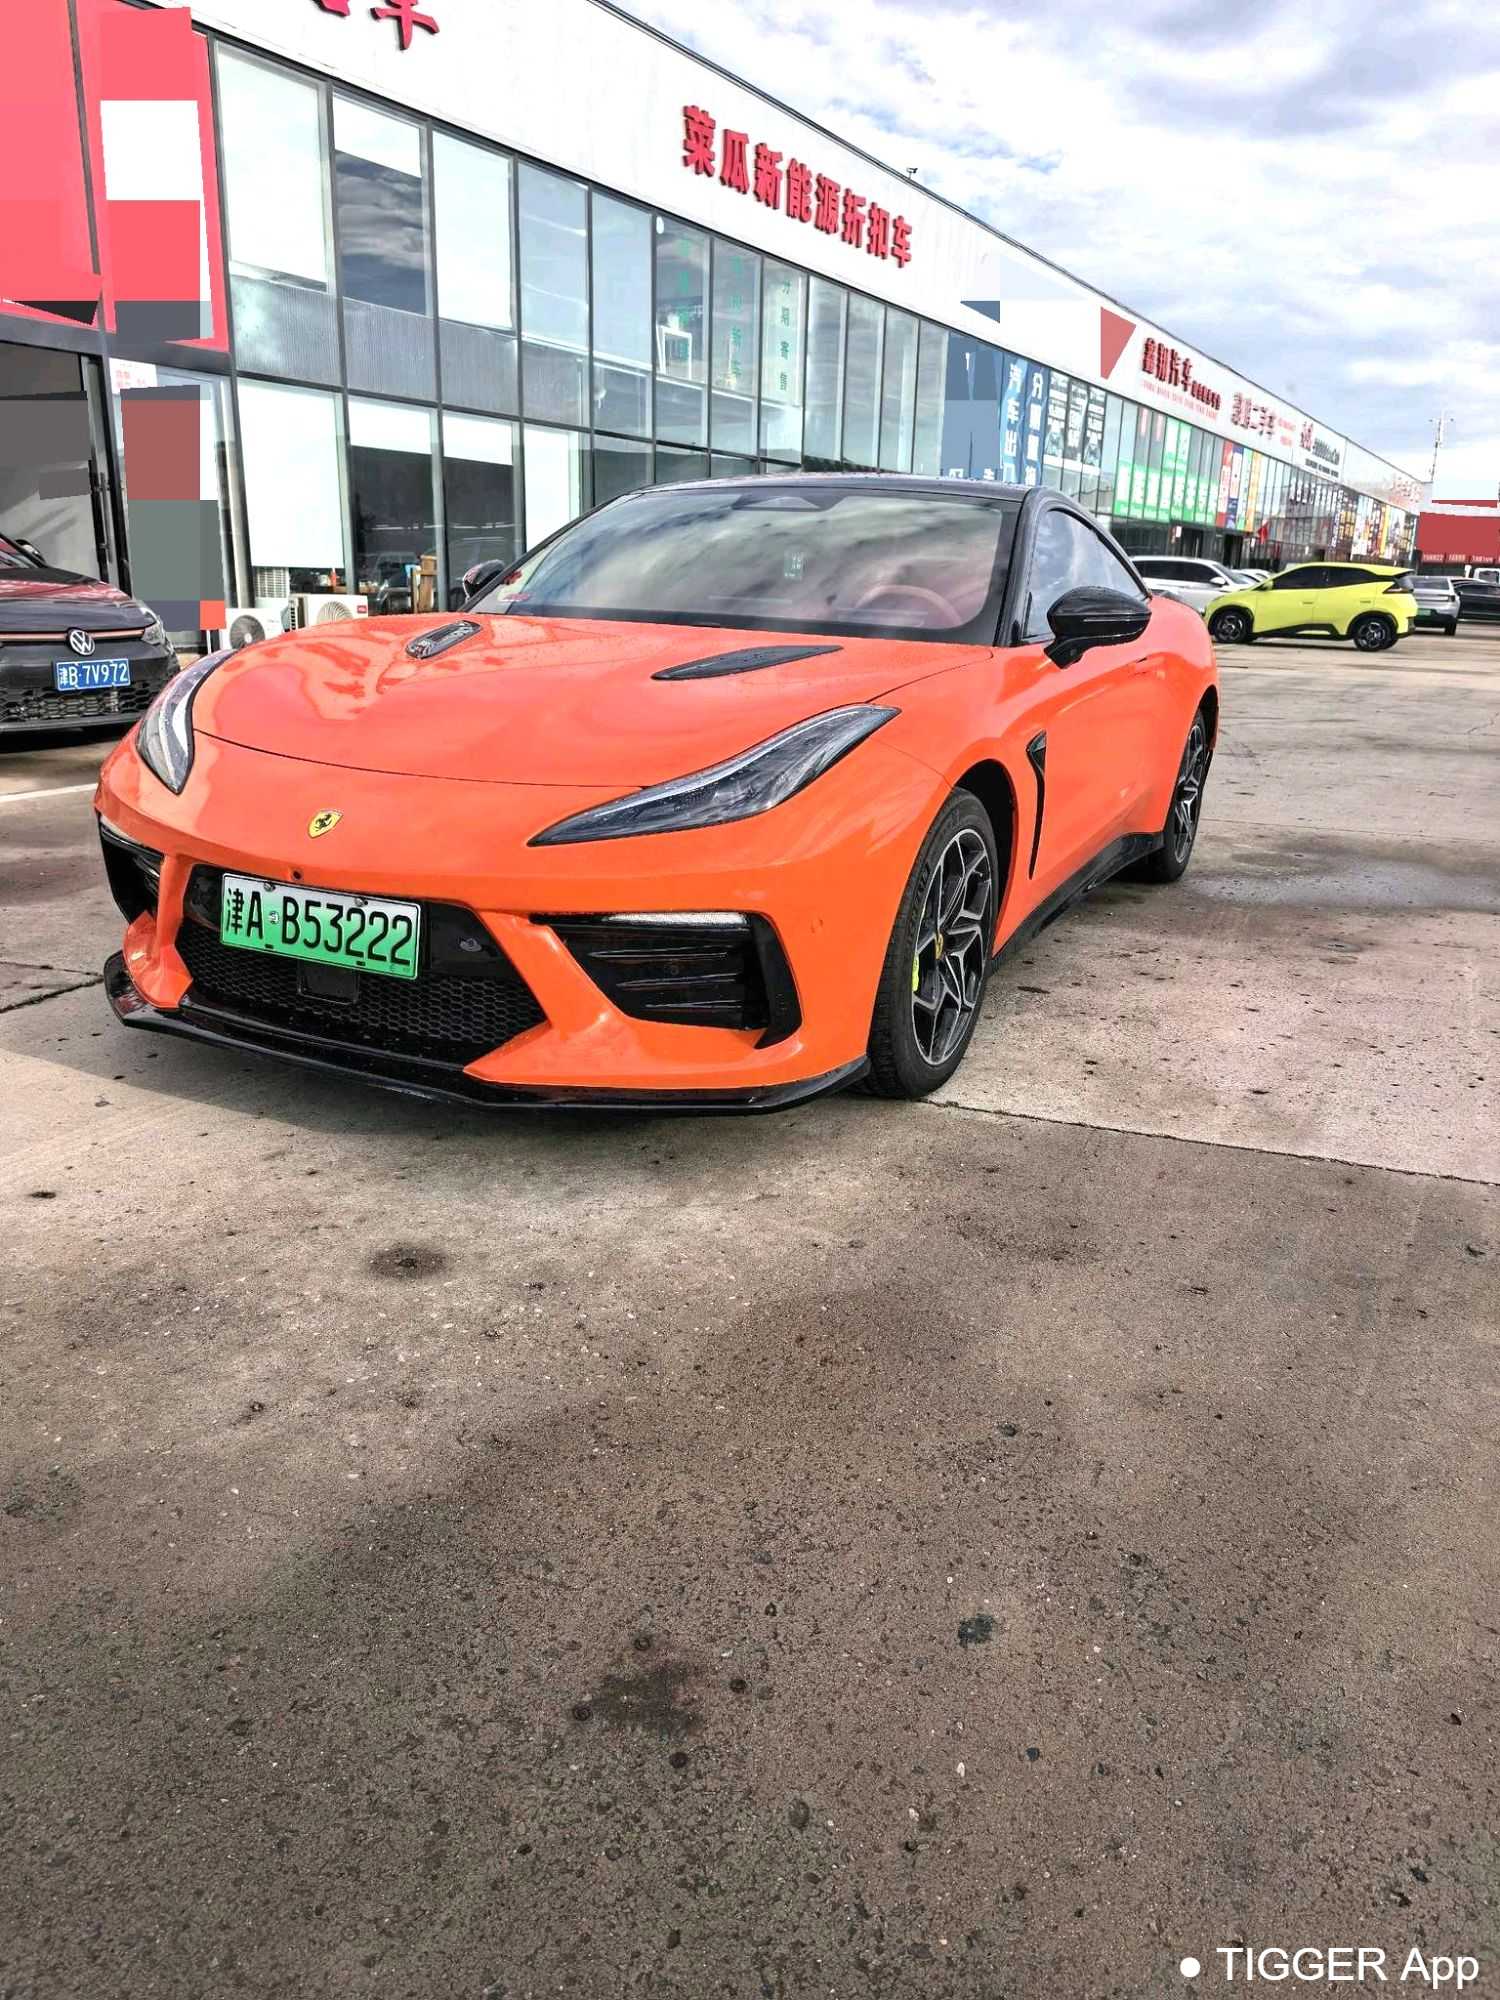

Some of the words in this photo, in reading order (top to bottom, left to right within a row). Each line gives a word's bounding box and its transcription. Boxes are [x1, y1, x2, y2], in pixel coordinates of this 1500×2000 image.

[683, 105, 913, 268] 菜瓜新能源折扣车
